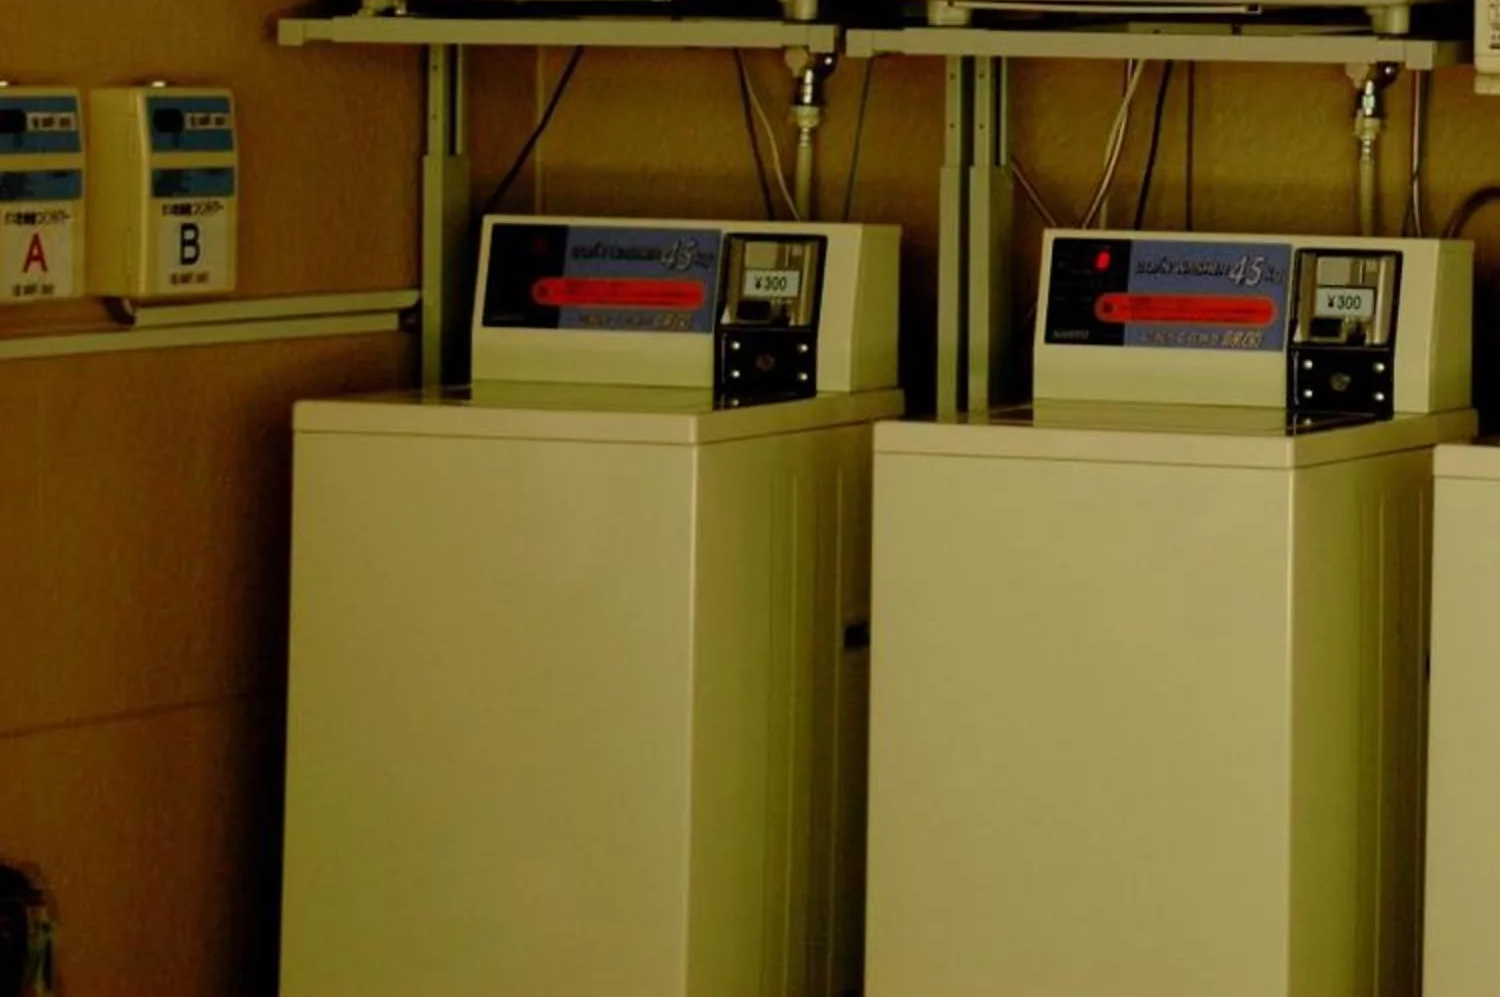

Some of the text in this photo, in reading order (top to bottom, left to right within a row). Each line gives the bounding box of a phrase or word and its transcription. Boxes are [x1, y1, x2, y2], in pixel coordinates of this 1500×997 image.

[22, 233, 48, 273] A
[180, 223, 200, 265] B
[754, 276, 788, 291] ¥300
[1327, 295, 1361, 310] ¥300
